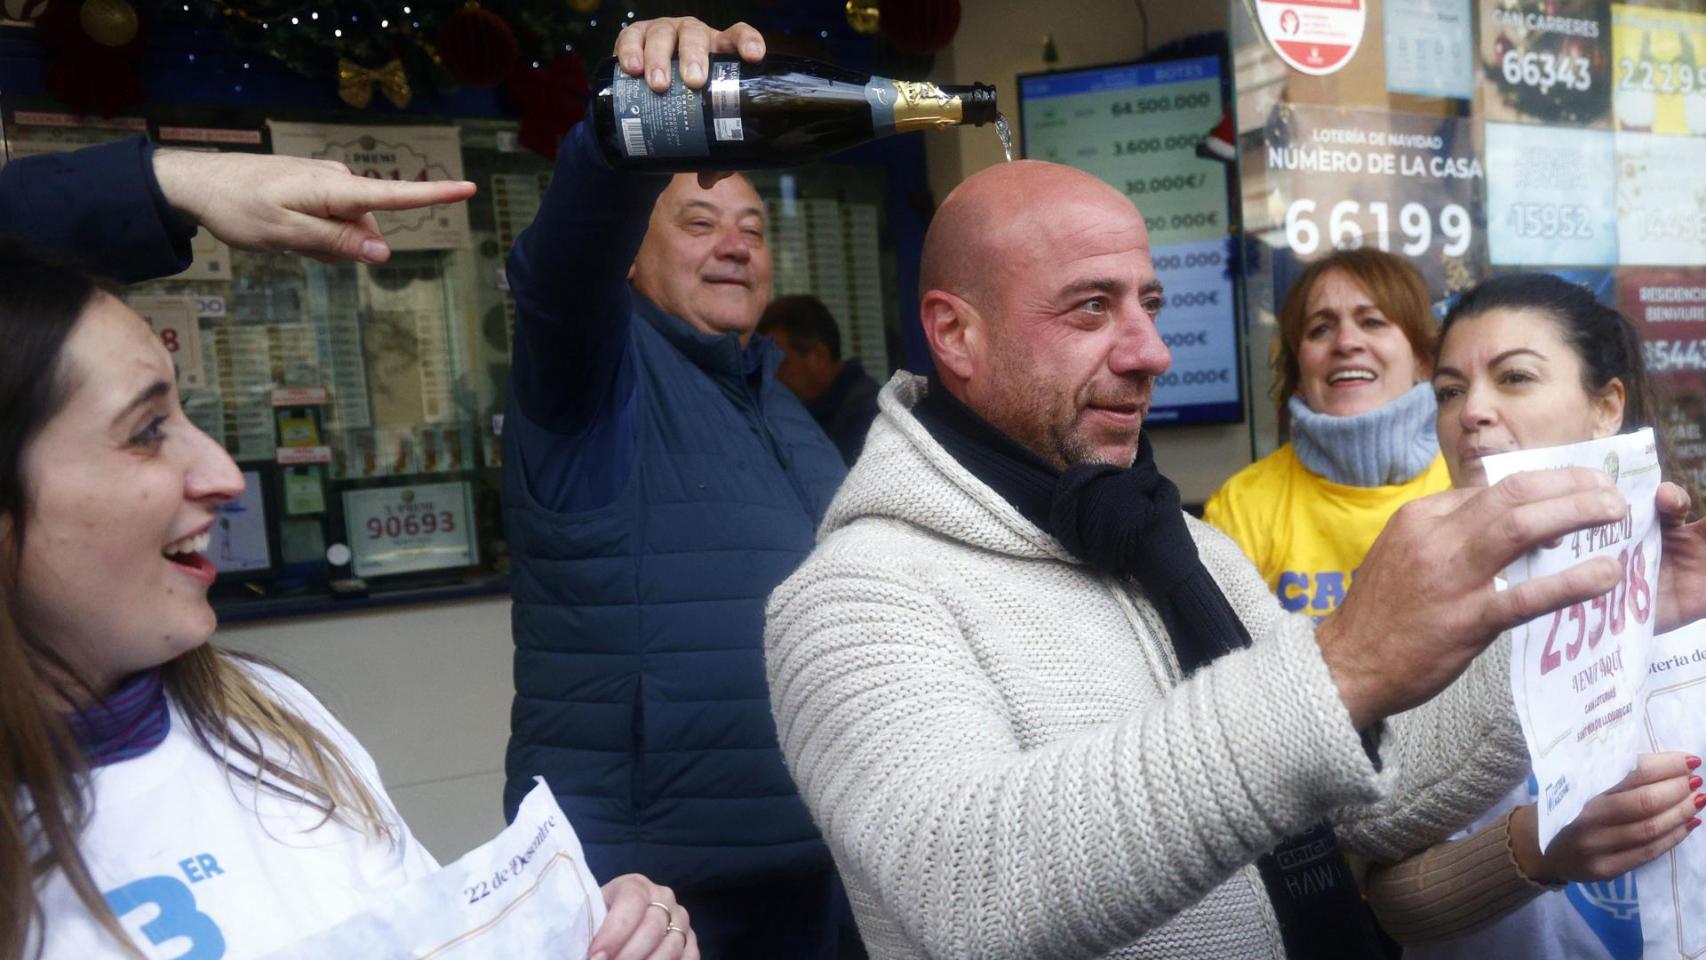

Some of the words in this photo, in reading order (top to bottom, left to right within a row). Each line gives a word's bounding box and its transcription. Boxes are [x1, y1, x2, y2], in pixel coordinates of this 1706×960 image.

[1492, 9, 1525, 27] CAN
[1526, 13, 1599, 38] CARRERES
[1502, 49, 1592, 91] 66343
[1111, 93, 1210, 118] 64.500.000
[1312, 128, 1366, 144] LOTERÍA
[1369, 132, 1386, 146] DE
[1388, 134, 1443, 150] NAVIDAD
[1268, 143, 1362, 173] NÚMERO
[1367, 153, 1396, 174] DE
[1401, 154, 1426, 176] LA
[1430, 157, 1484, 179] CASA
[1285, 198, 1472, 257] 66199
[1511, 202, 1594, 238] 15952
[366, 511, 455, 540] 90693
[1277, 569, 1358, 611] CA
[1648, 655, 1690, 675] teria
[464, 881, 490, 904] 22
[492, 872, 508, 889] de
